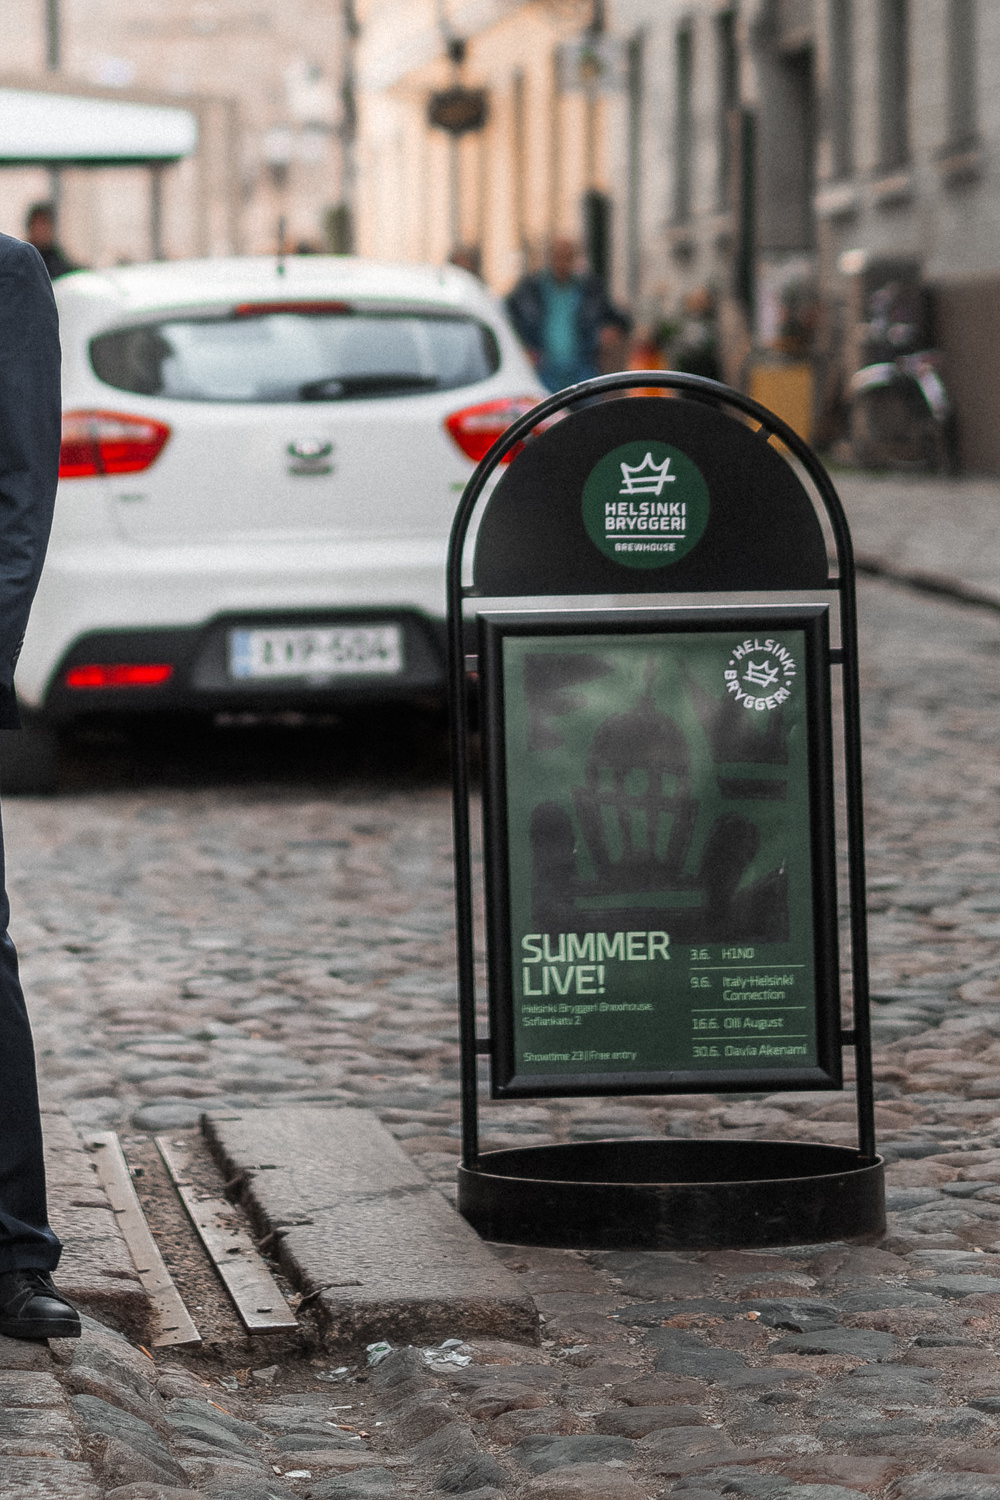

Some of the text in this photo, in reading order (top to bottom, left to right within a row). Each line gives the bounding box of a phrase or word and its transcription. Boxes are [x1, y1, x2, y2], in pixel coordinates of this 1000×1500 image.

[605, 502, 686, 516] HELSINKI
[605, 517, 686, 531] BRYGGERI
[614, 543, 676, 552] BREWHOUSE
[732, 639, 797, 676] HELSINKI
[724, 670, 791, 711] BRYGGERI
[521, 931, 671, 963] SUMMER
[523, 965, 605, 996] LIVE!
[722, 989, 786, 1000] Connection
[723, 1017, 740, 1029] Olli
[743, 1017, 784, 1030] August
